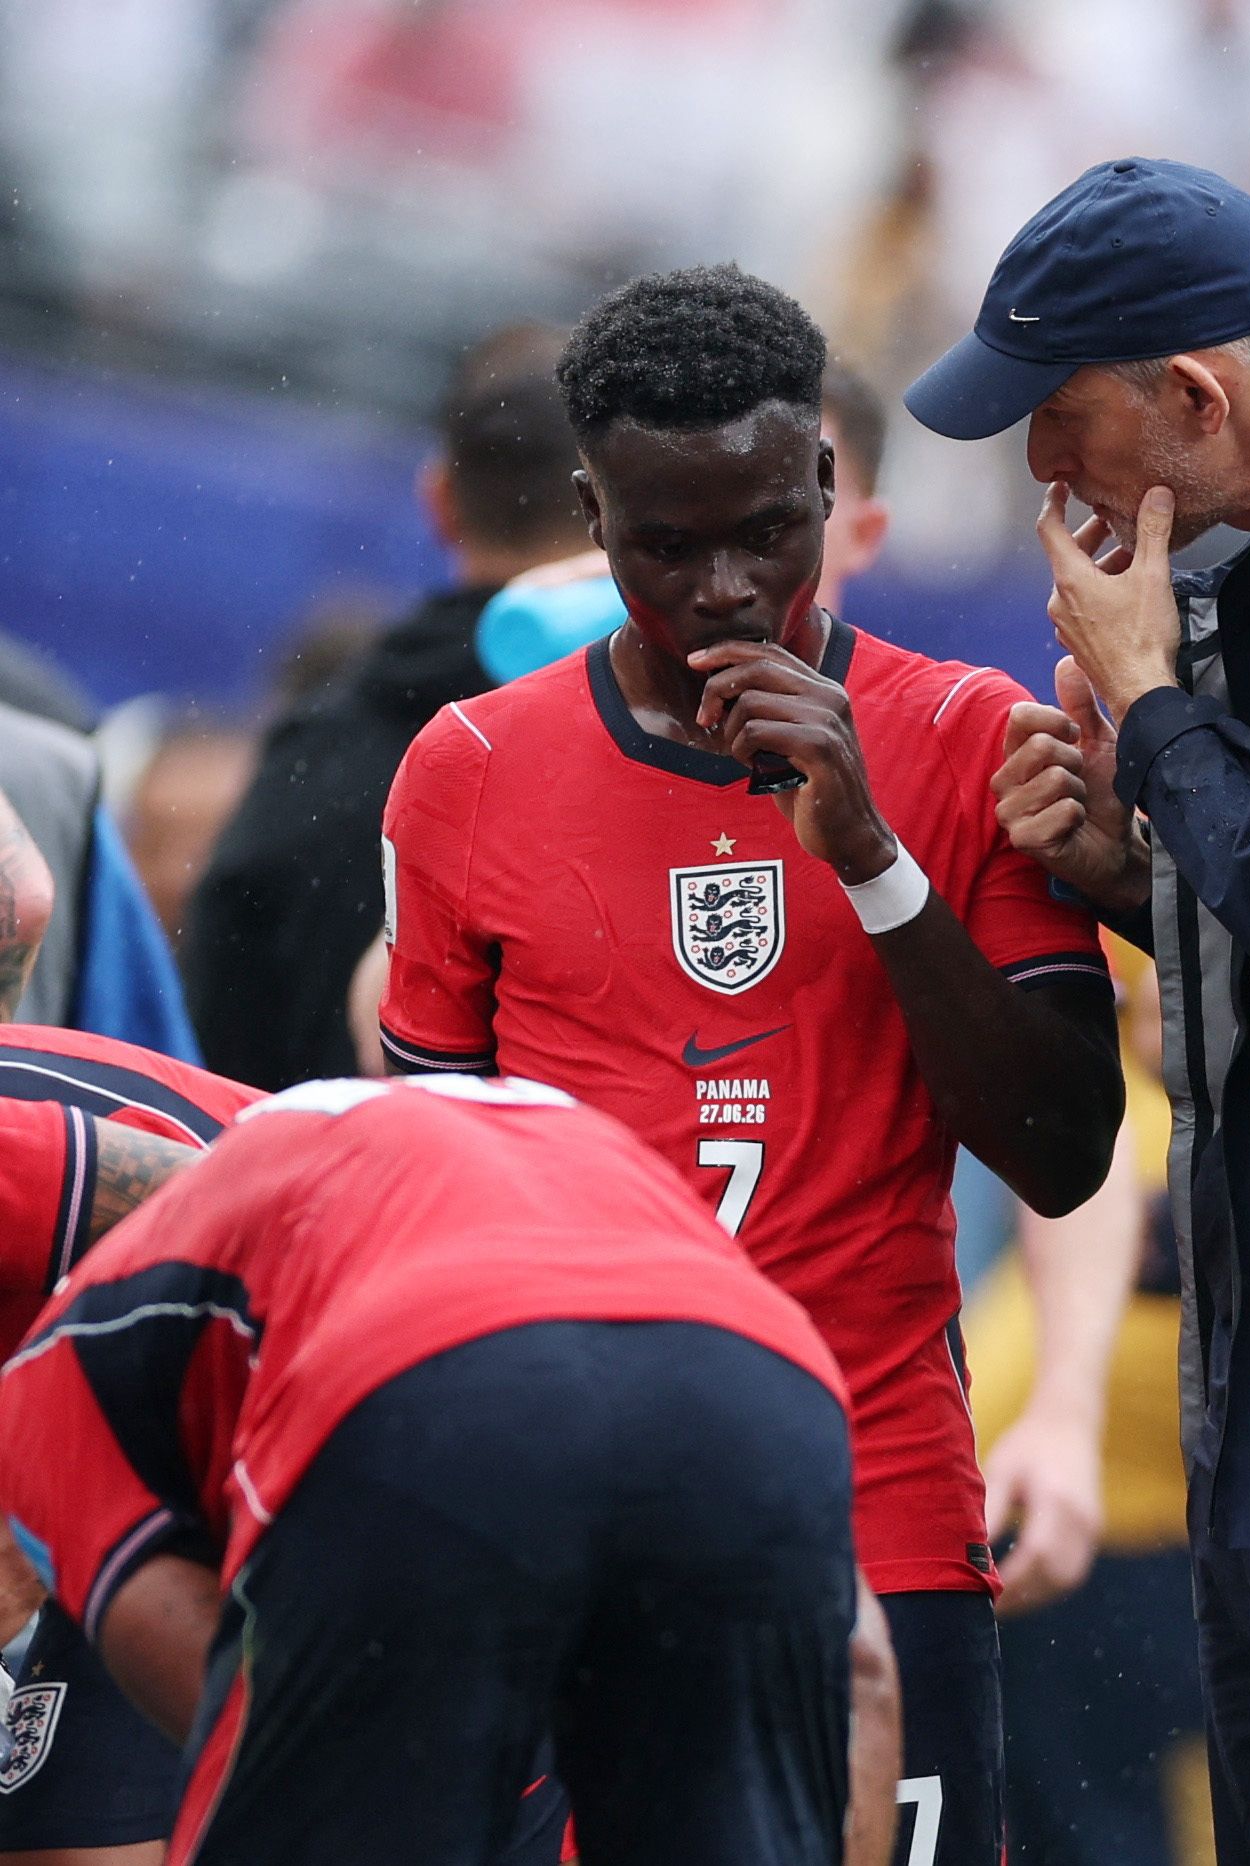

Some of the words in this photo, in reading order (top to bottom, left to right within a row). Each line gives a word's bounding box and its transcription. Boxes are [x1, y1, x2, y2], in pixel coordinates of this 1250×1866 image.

[696, 1079, 770, 1100] PANAMA
[699, 1103, 766, 1124] 27.06.26
[697, 1138, 765, 1239] 7
